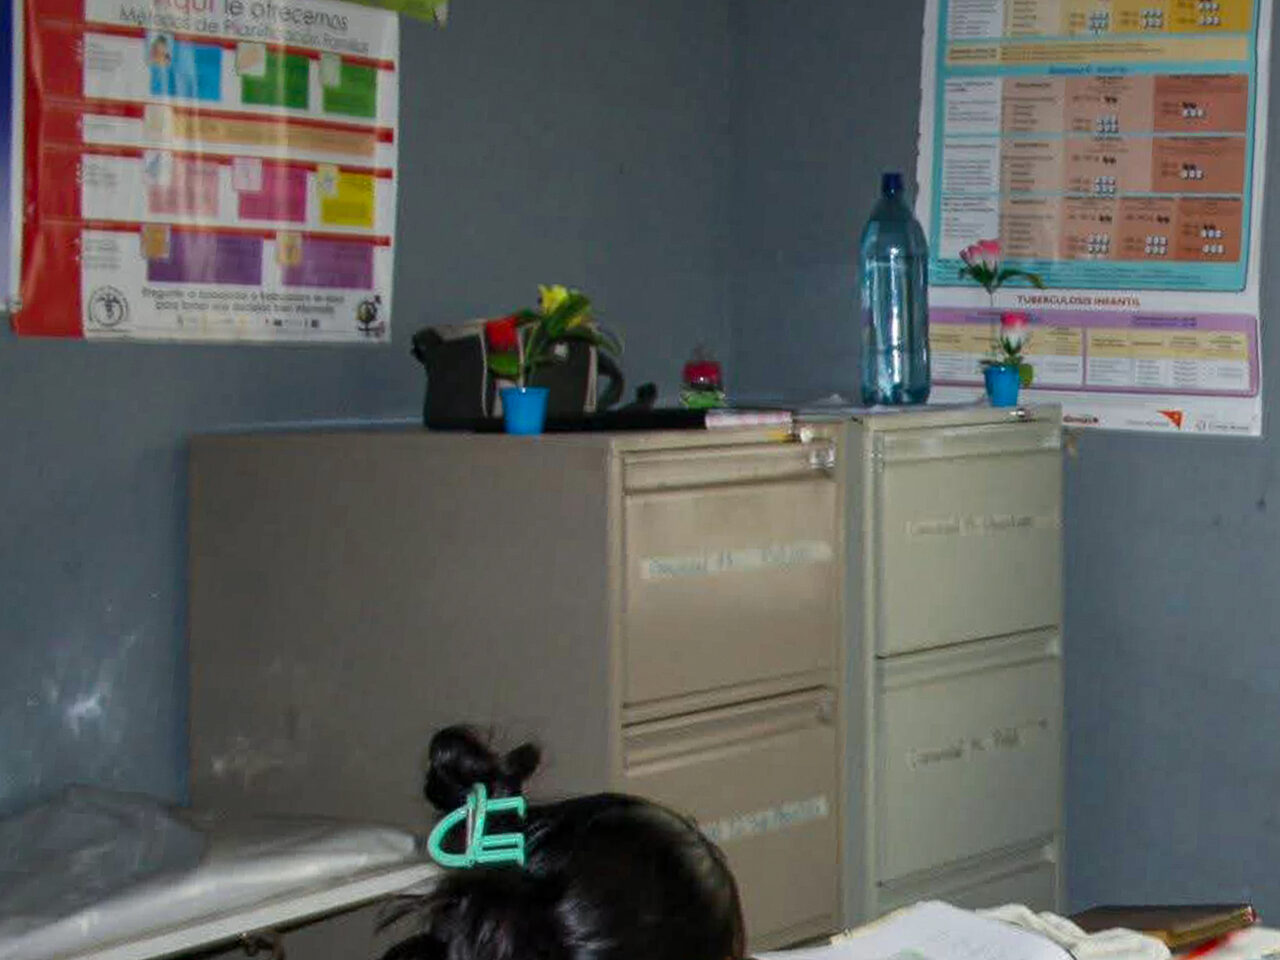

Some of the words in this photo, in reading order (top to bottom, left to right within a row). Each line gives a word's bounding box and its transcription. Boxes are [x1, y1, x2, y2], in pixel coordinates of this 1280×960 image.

[224, 0, 245, 16] le
[250, 0, 348, 31] ofrecemos
[196, 17, 220, 34] de
[1017, 295, 1092, 305] TUBERCULOSIS
[1093, 296, 1141, 307] INFANTIL
